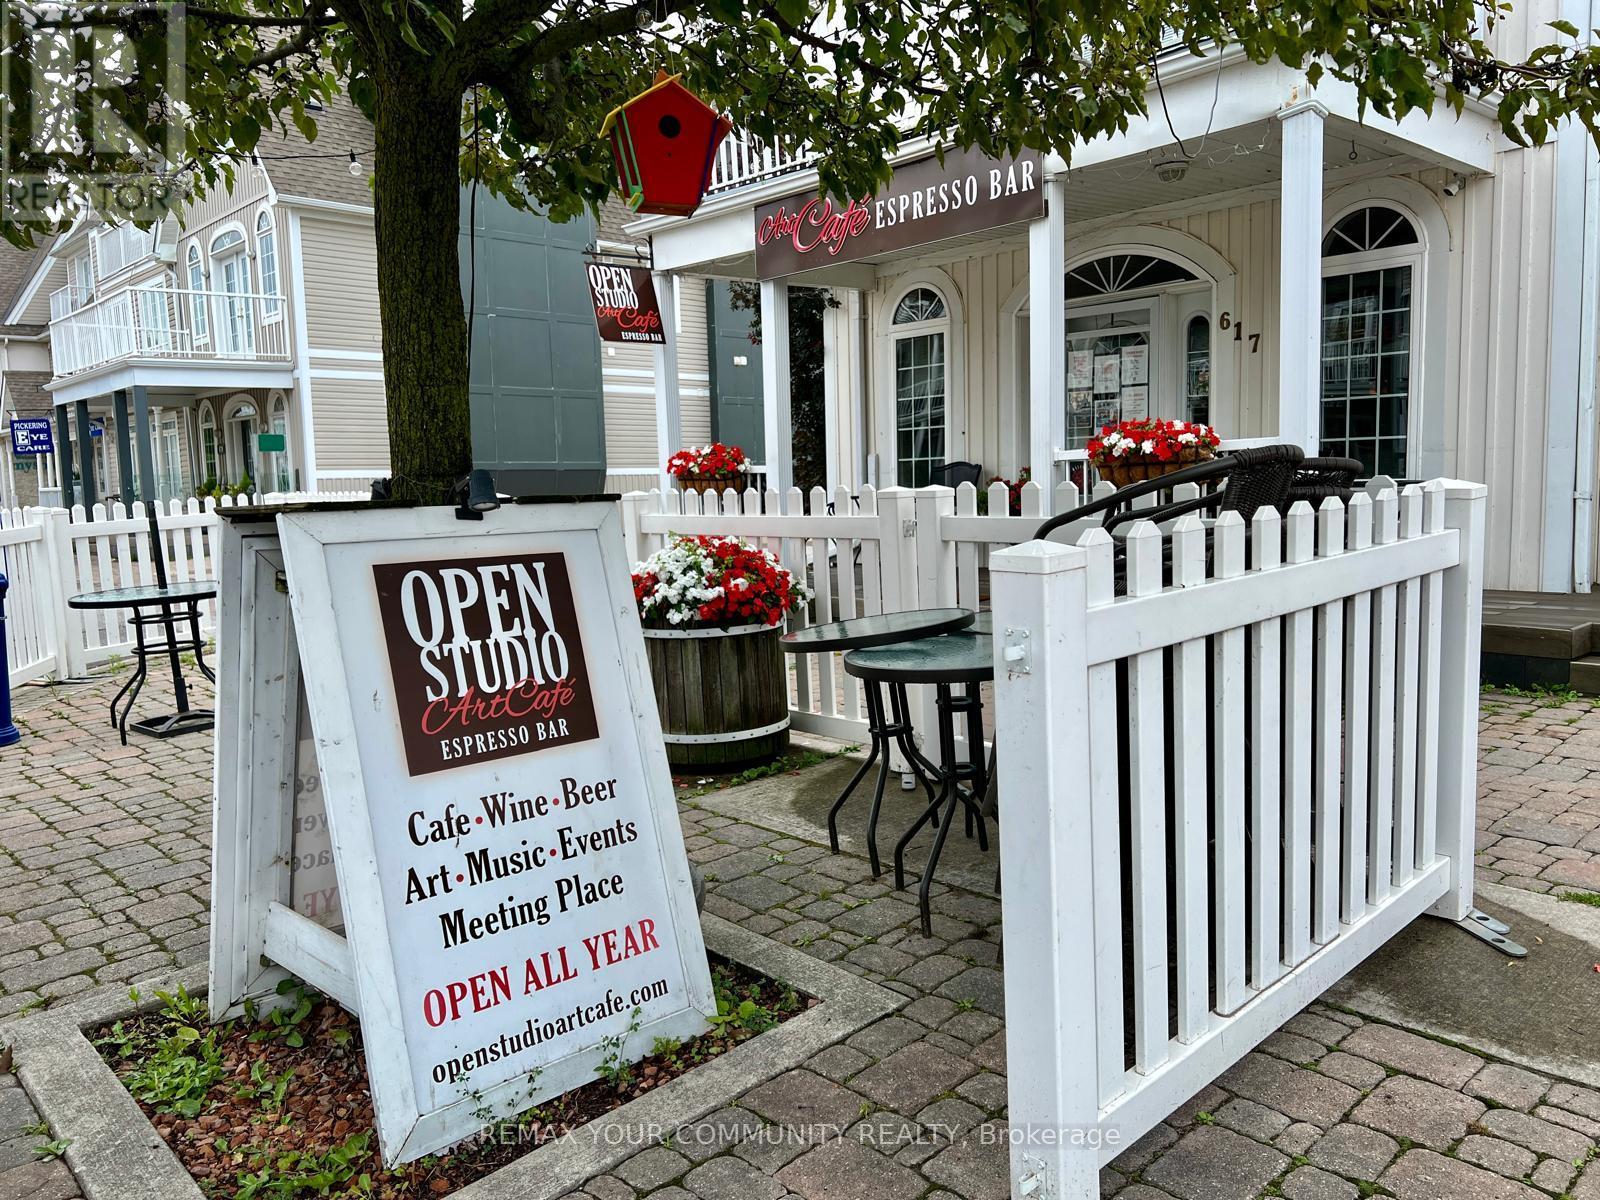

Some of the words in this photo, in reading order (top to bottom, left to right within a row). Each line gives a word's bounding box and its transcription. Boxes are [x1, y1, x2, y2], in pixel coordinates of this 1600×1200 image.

[875, 175, 978, 230] ESPRESSO
[989, 160, 1035, 200] BAR
[588, 265, 634, 292] OPEN
[595, 288, 639, 309] STUDIO
[621, 331, 650, 341] ESPRESSO
[650, 332, 663, 342] BAR
[401, 561, 555, 648] OPEN
[420, 631, 569, 702] STUDIO
[440, 725, 529, 761] ESPRESSO
[536, 718, 569, 741] BAR
[408, 804, 471, 847] Cafe
[480, 792, 549, 828] Wine
[560, 777, 617, 810] Beer
[405, 865, 453, 905] Art
[465, 840, 547, 886] Music
[557, 819, 638, 860] Events
[439, 895, 551, 949] Meeting
[555, 873, 624, 913] Place
[423, 965, 512, 1028] OPEN
[524, 946, 578, 995] ALL
[582, 918, 660, 970] YEAR
[432, 977, 669, 1084] openstudioartcafe.com
